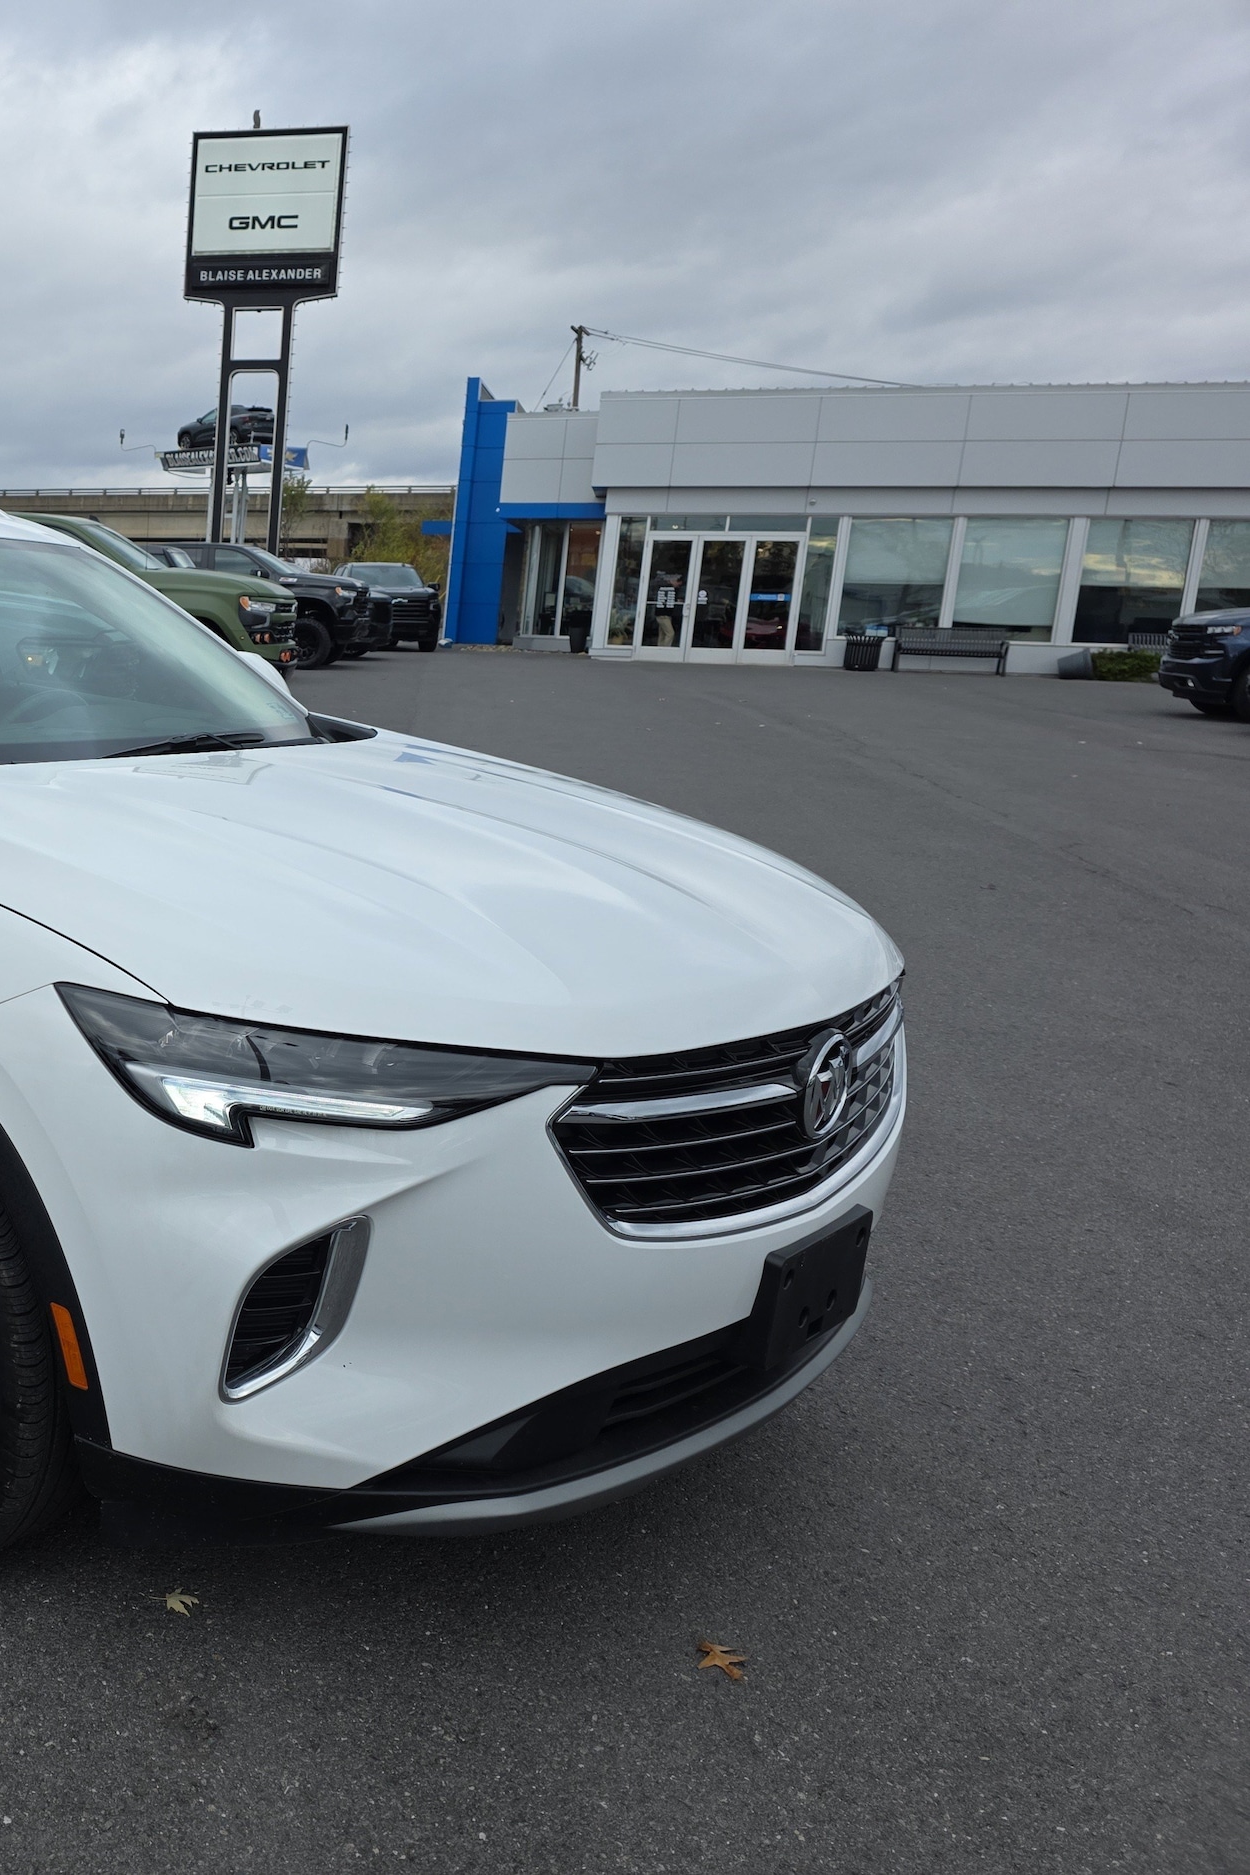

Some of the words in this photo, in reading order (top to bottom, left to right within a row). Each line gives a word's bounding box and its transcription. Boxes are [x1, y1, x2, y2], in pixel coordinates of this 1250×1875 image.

[204, 160, 331, 173] CHEVROLET
[228, 214, 299, 230] GMC
[199, 269, 245, 282] BLAISE
[246, 267, 322, 281] ALEXANDER
